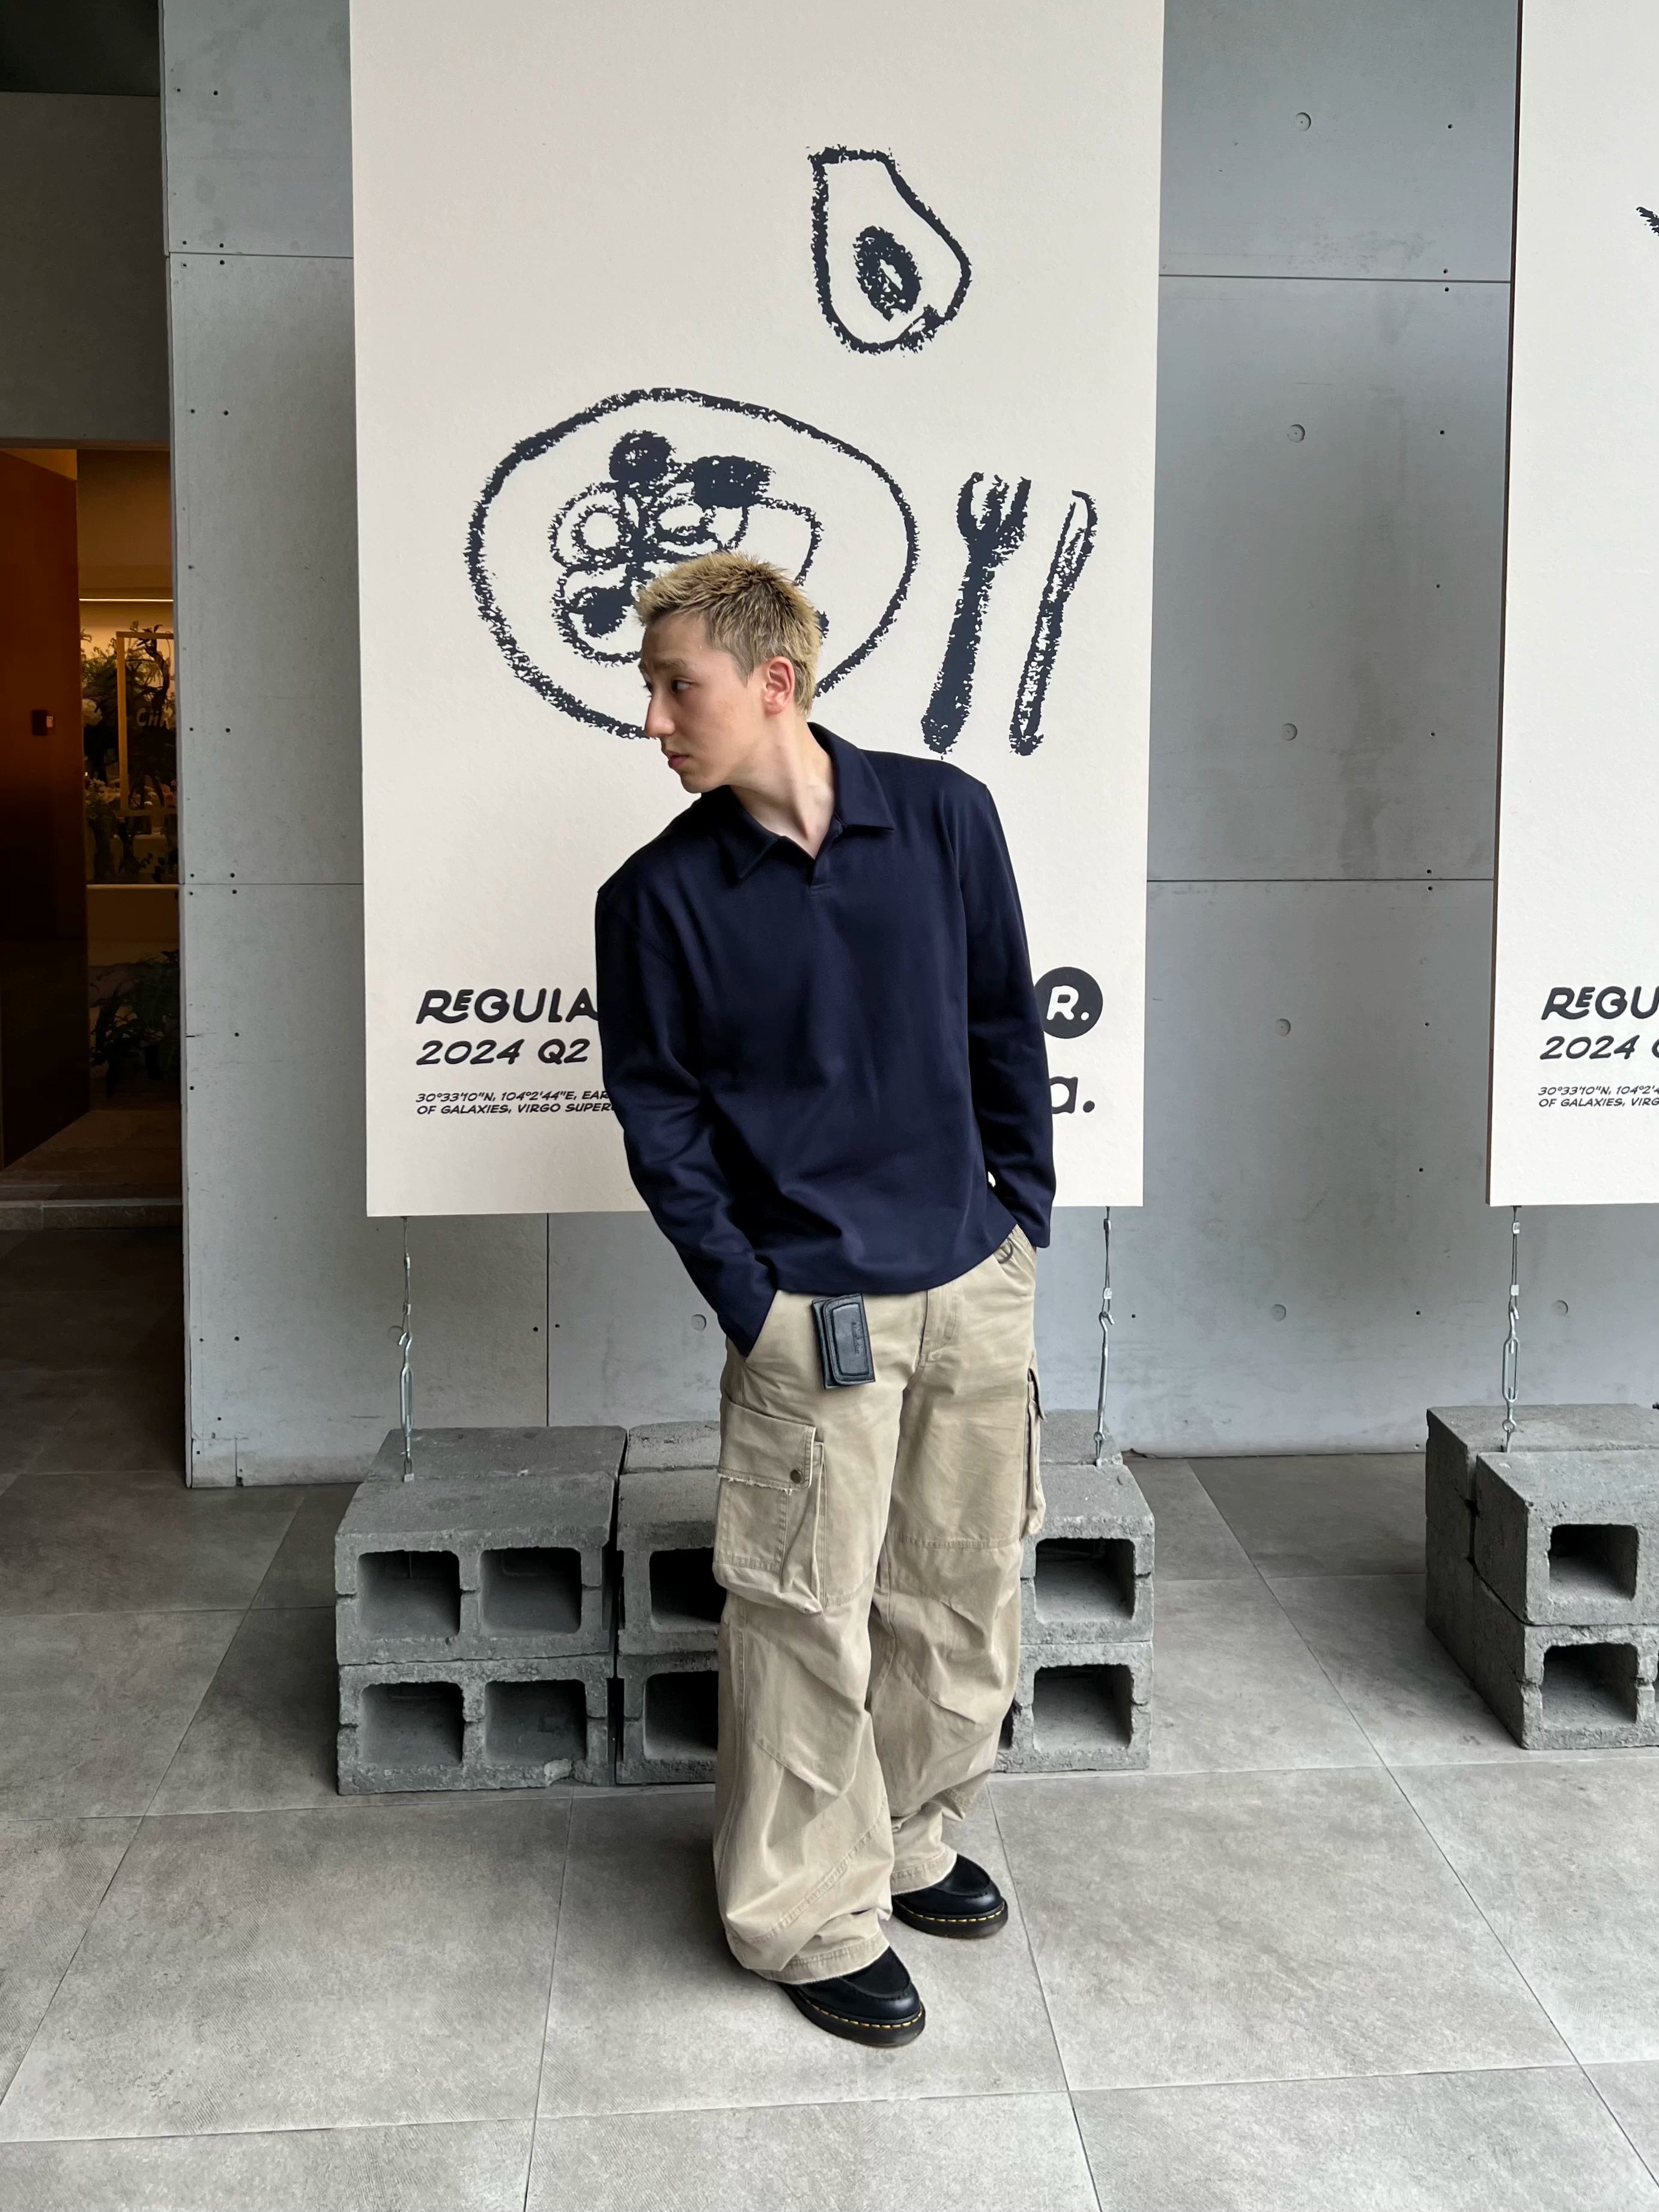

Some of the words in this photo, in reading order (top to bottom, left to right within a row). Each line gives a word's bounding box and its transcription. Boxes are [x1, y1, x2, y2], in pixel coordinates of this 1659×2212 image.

[416, 987, 599, 1025] REGULA
[1046, 985, 1090, 1020] R.
[1541, 986, 1659, 1020] REGU
[416, 1038, 525, 1065] 2024
[538, 1038, 590, 1065] Q2
[1539, 1035, 1640, 1060] 2024
[417, 1104, 437, 1115] OF
[441, 1104, 512, 1114] GALAXIES,
[518, 1103, 561, 1114] VIRGO
[565, 1102, 614, 1112] SUPER
[1539, 1098, 1557, 1107] OF
[1560, 1098, 1625, 1107] GALAXIES,
